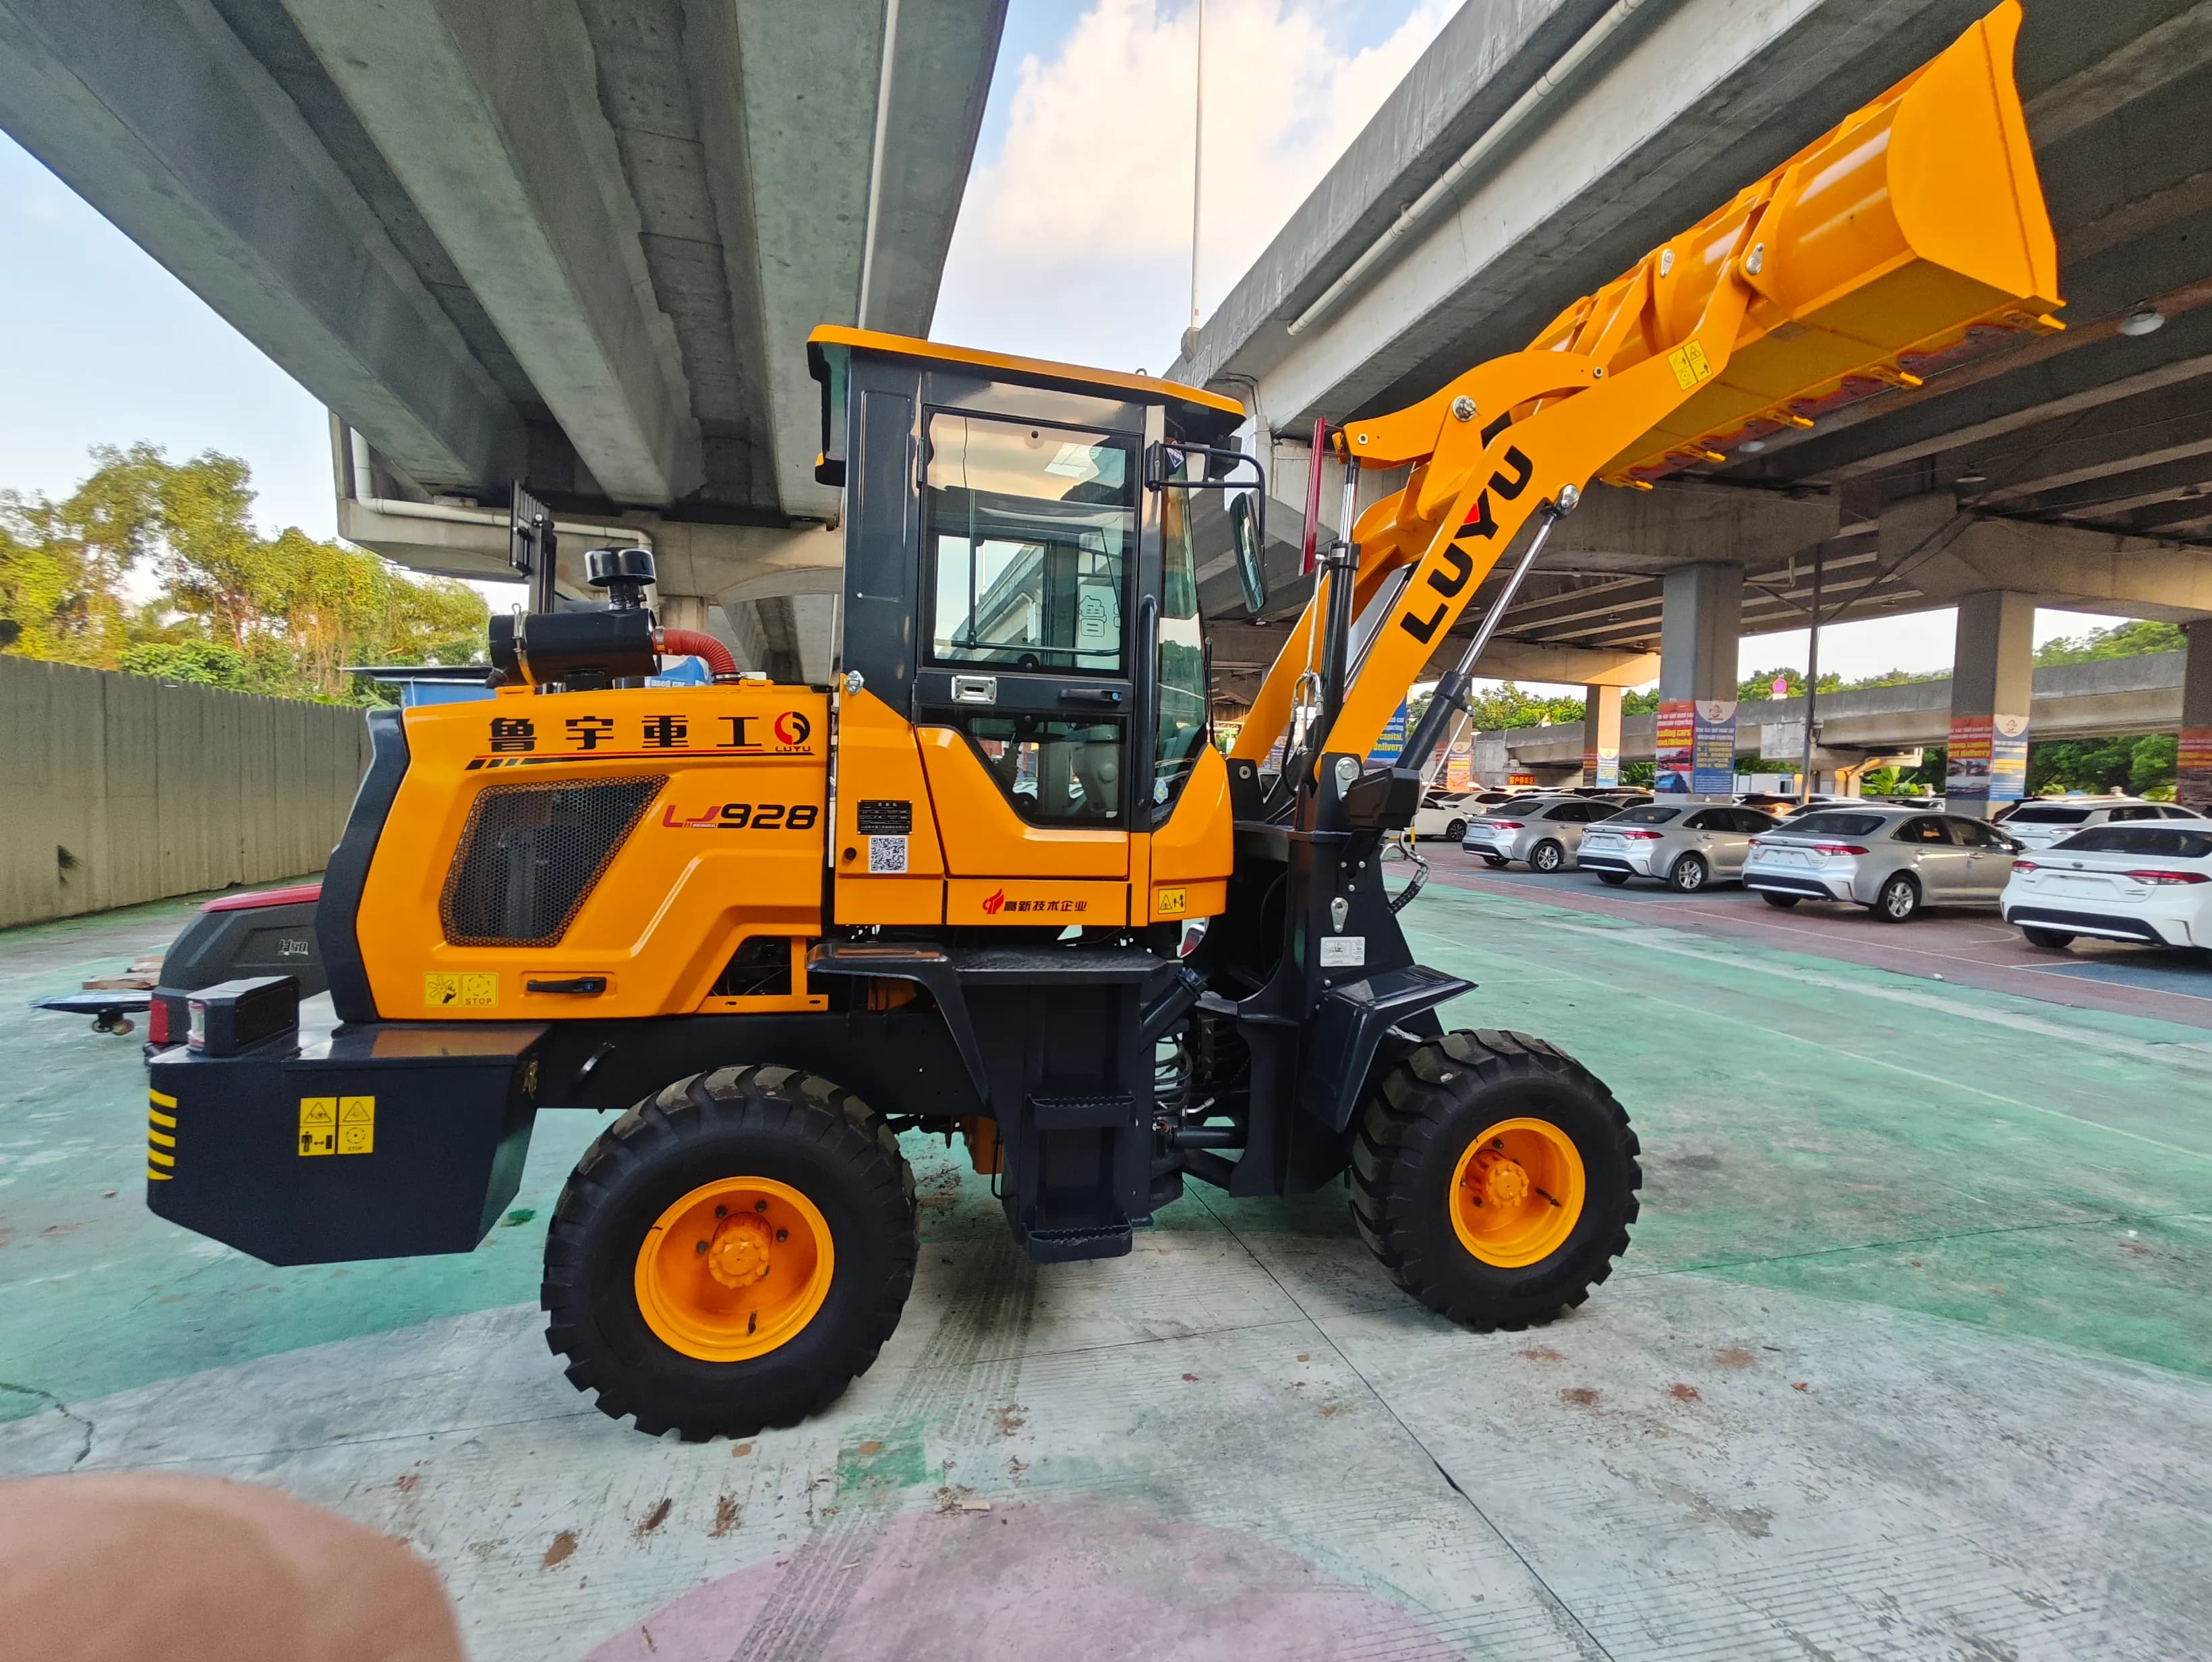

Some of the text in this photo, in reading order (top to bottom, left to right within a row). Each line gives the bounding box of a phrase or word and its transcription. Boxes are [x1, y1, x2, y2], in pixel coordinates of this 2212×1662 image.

[1400, 445, 1533, 644] LUYU
[488, 715, 767, 752] 鲁宇重工
[662, 803, 819, 830] LJ928
[1003, 900, 1088, 912] 高新技术企业
